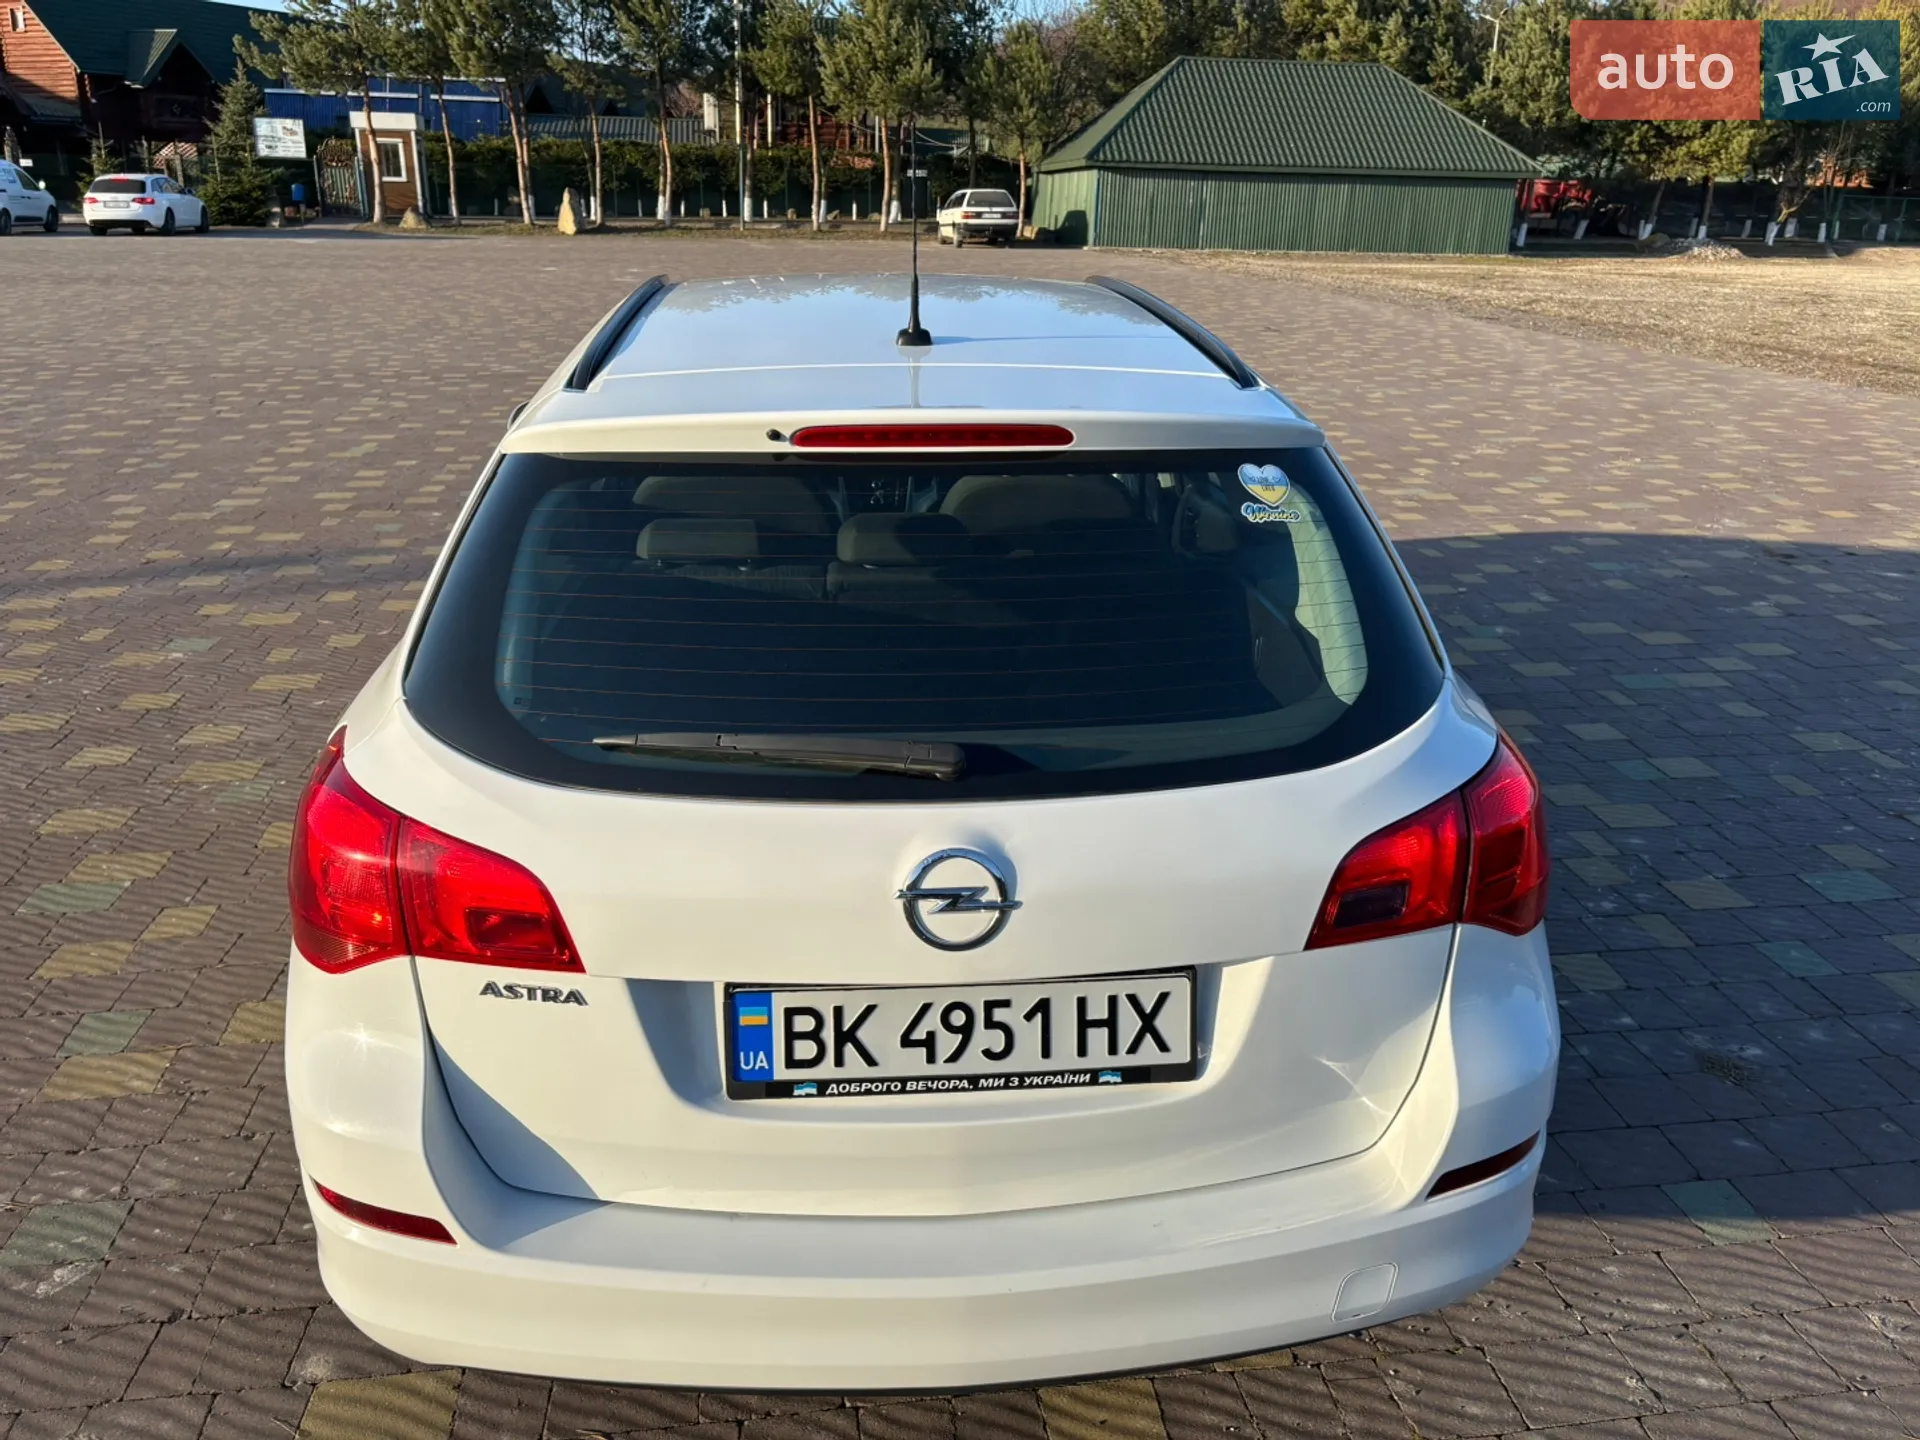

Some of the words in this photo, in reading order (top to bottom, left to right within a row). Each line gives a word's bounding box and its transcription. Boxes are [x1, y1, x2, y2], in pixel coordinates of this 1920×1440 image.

[479, 980, 589, 1006] ASTRA
[783, 1003, 879, 1069] BK
[899, 996, 1051, 1064] 4951
[1076, 991, 1172, 1058] HX
[739, 1051, 769, 1071] UA
[826, 1081, 902, 1095] ДОБРОГО
[978, 1077, 1005, 1089] МИ
[1022, 1073, 1091, 1086] УКРАЇНИ
